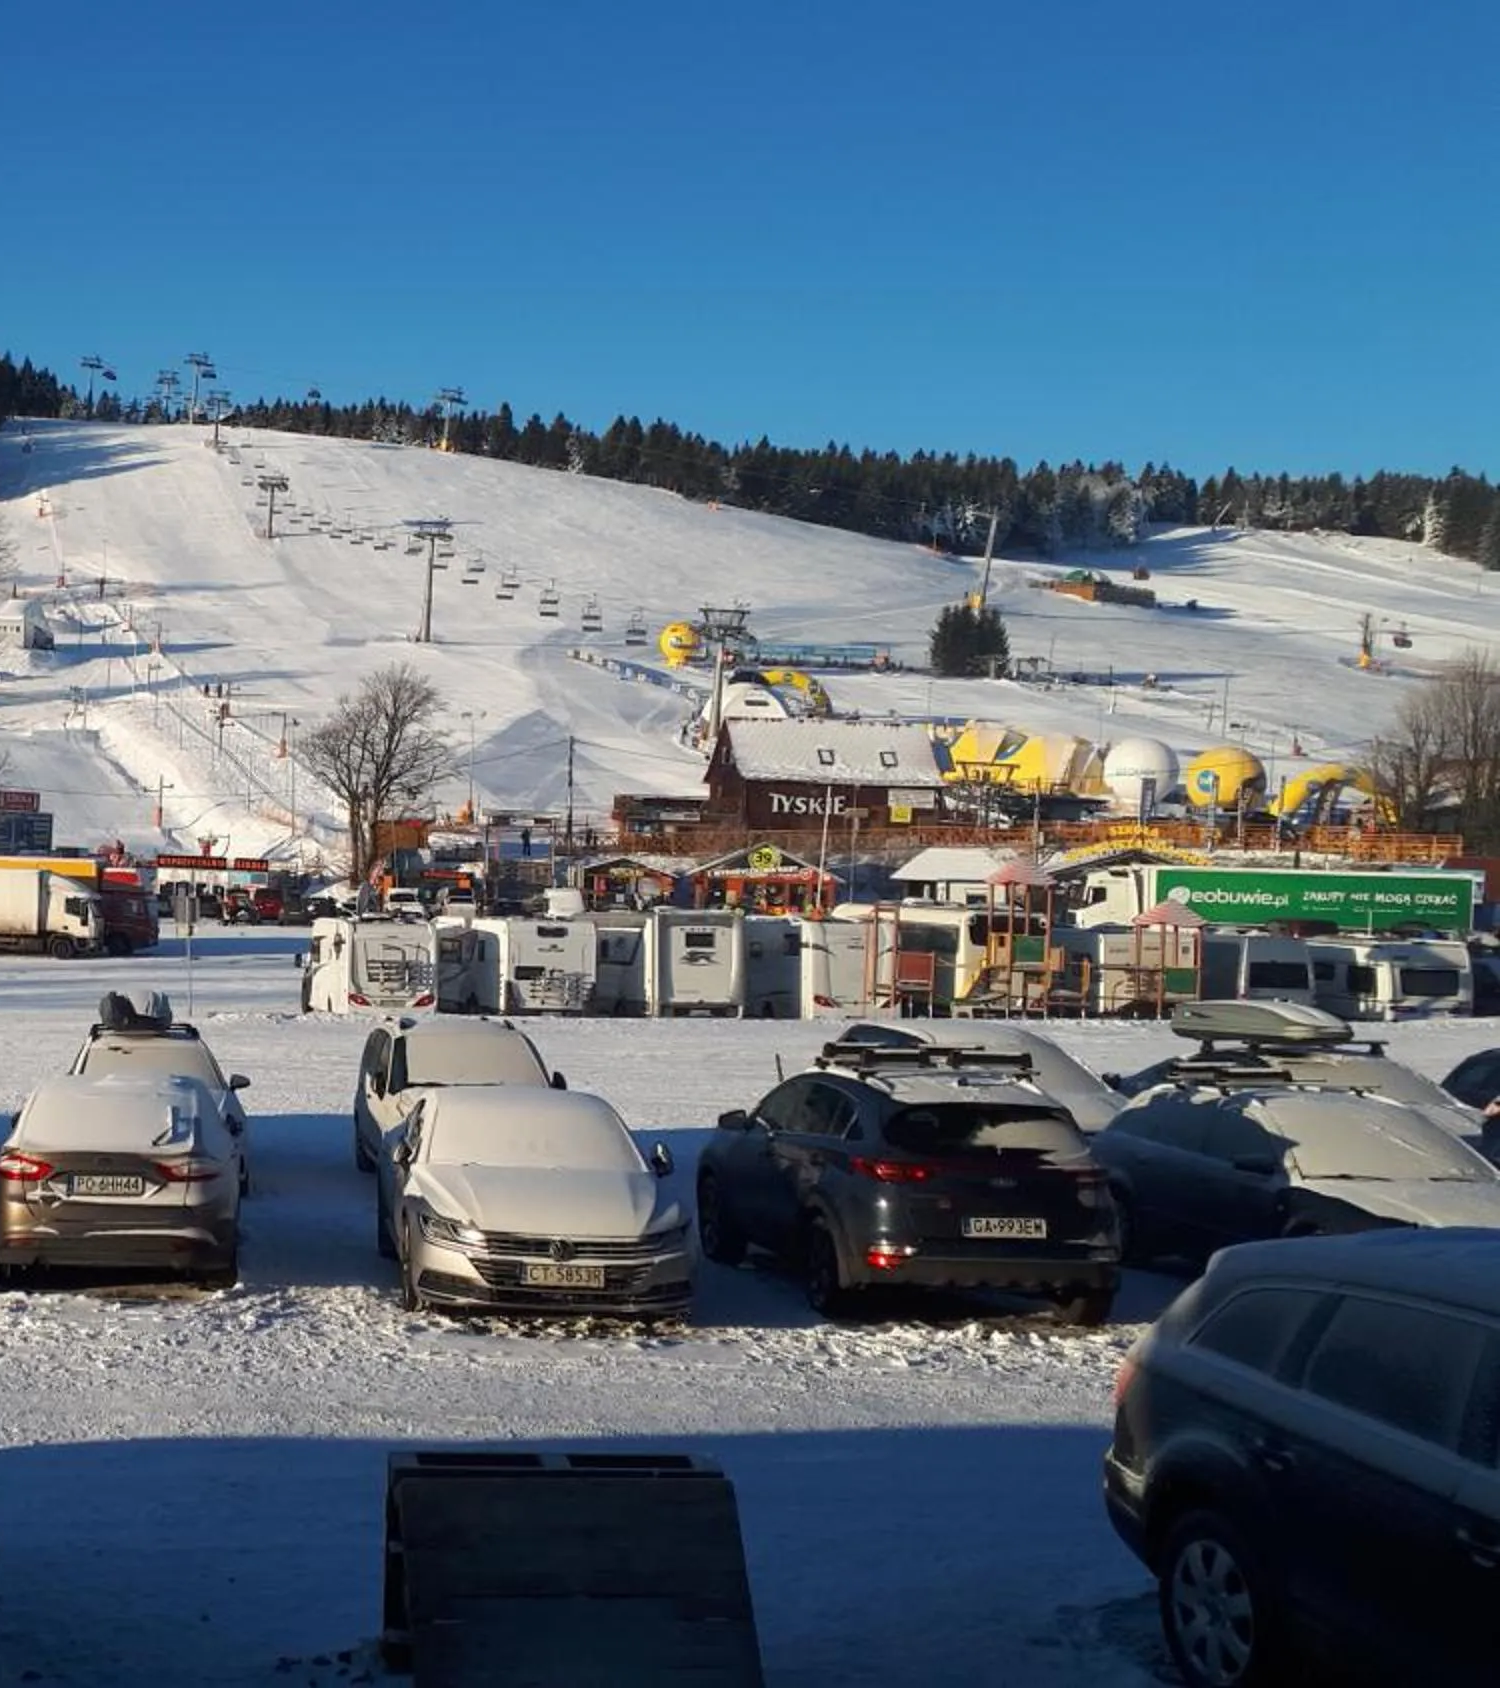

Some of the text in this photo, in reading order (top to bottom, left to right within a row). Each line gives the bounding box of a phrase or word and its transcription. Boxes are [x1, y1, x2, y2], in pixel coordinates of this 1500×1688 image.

[768, 792, 848, 815] TYSKIE
[754, 850, 773, 864] 39
[1191, 887, 1289, 908] eobuwie.pl
